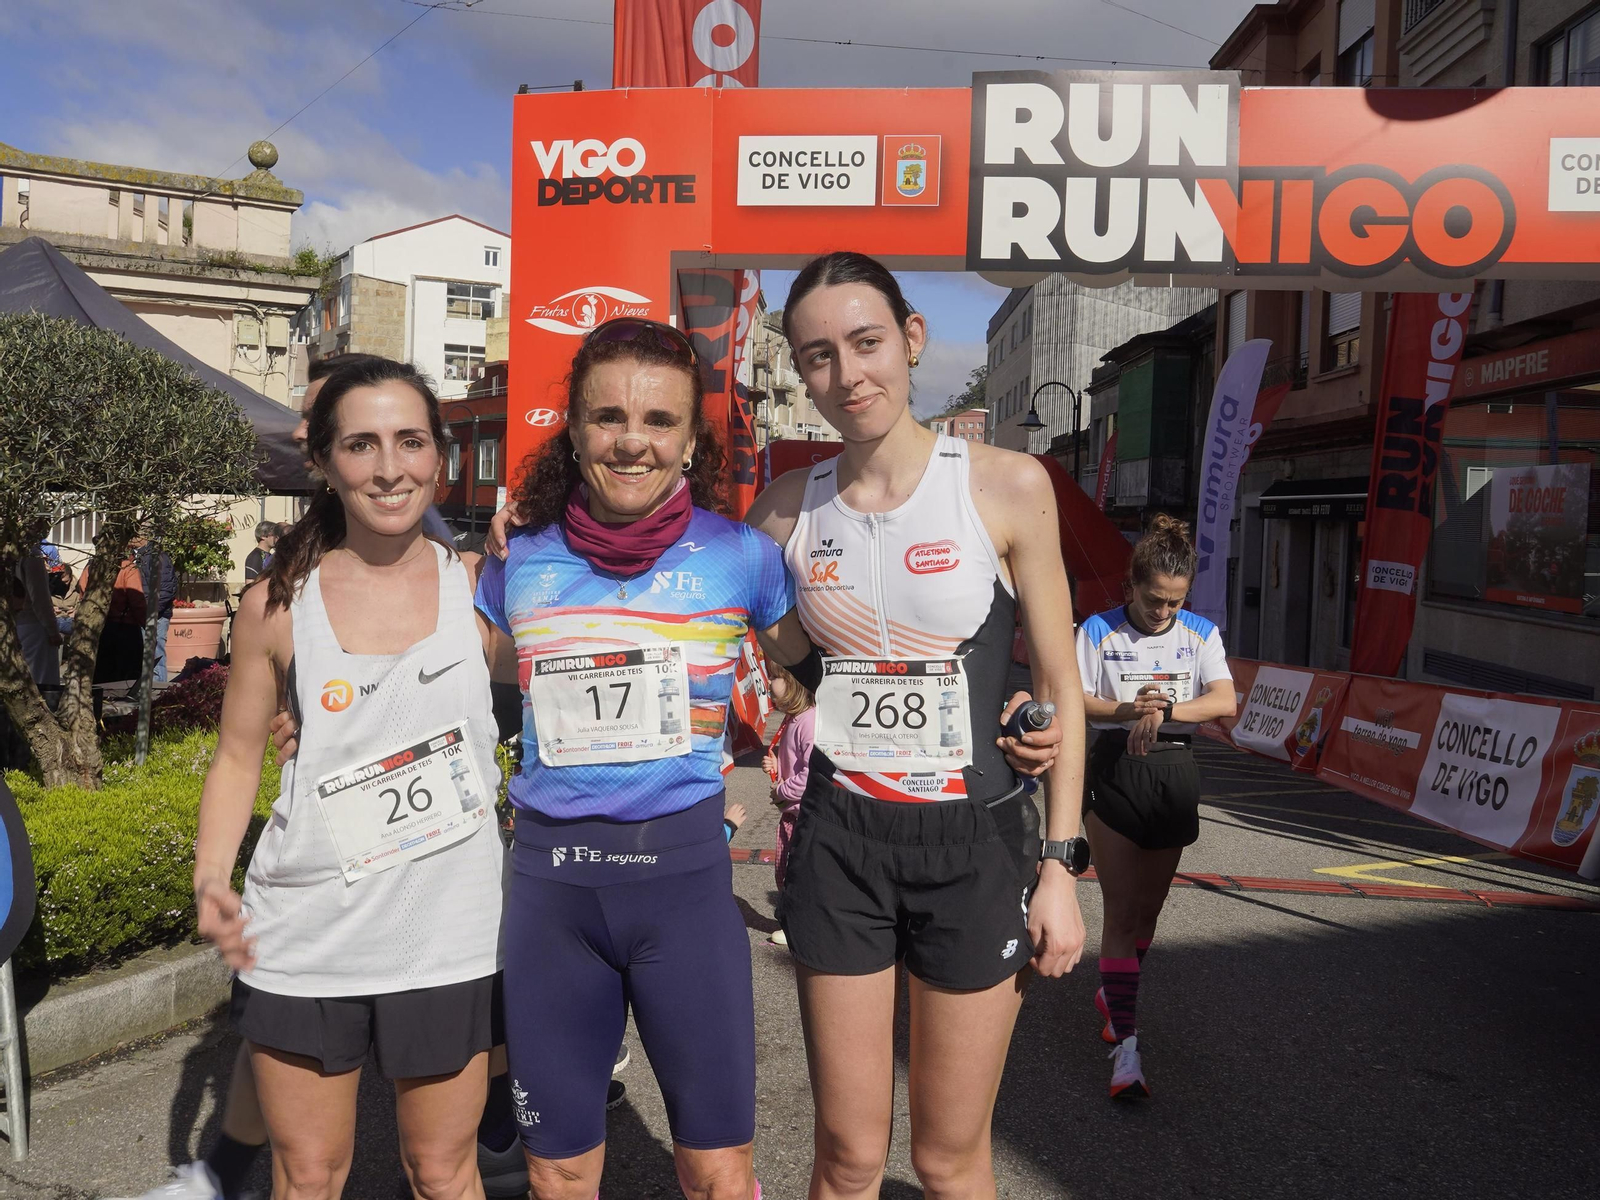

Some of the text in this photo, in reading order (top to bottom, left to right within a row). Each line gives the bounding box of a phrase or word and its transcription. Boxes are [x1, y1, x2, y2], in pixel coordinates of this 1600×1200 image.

[984, 83, 1229, 166] RUN
[530, 138, 646, 179] VIGO
[749, 151, 865, 168] CONCELLO
[1561, 154, 1600, 171] CO
[537, 175, 696, 207] DEPORTE
[762, 173, 850, 190] DE VIGO
[530, 304, 650, 317] Frutas Nieves
[1481, 349, 1549, 385] MAPFRE
[1203, 394, 1240, 523] amura
[1220, 417, 1249, 511] SPORTWEAR
[1376, 396, 1424, 512] RUN
[1509, 487, 1566, 513] DE COCHE
[810, 547, 843, 558] amura
[914, 547, 951, 558] ATLETISMO
[915, 558, 950, 568] SANTIAGO
[675, 571, 703, 591] FE
[825, 583, 855, 592] Deportiva
[1373, 575, 1386, 584] DE
[670, 591, 706, 601] seguros
[580, 670, 615, 681] CARREIRA
[616, 669, 627, 677] DE
[627, 667, 643, 675] TEIS
[936, 676, 958, 687] 10K
[585, 681, 632, 721] 17
[1250, 683, 1301, 713] CONCELLO
[851, 691, 927, 730] 268
[577, 723, 639, 734] Julia VAQUERO SOUSA
[1243, 710, 1260, 732] DE
[1258, 714, 1285, 739] VIGO
[442, 743, 462, 759] 10K
[563, 746, 590, 754] Santander
[1438, 720, 1538, 769] CONCELLO
[360, 758, 433, 792] VII CARREIRA DE TEIS
[1431, 762, 1510, 811] DE VIGO
[378, 775, 433, 825] 26
[381, 811, 442, 839] Ana ALONSO HERRERO
[371, 847, 400, 862] Santander
[573, 846, 658, 866] FE seguros
